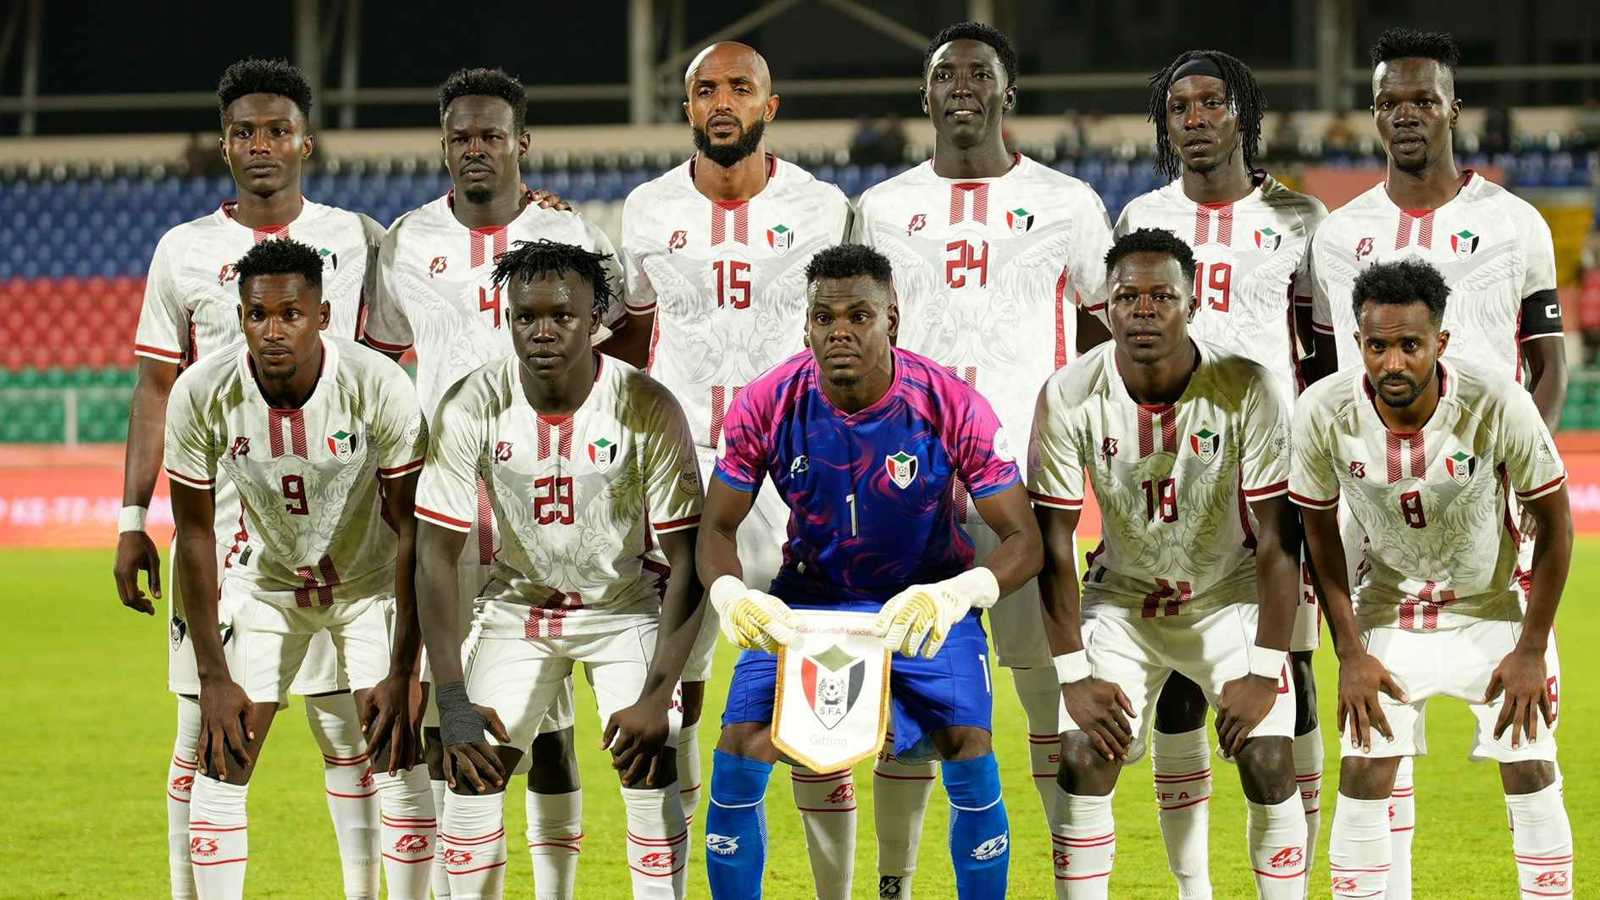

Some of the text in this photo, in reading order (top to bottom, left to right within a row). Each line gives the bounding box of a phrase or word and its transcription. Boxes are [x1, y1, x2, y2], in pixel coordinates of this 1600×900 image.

[712, 260, 751, 309] 15
[946, 239, 989, 289] 24
[479, 283, 501, 330] 4
[1194, 262, 1232, 313] 19
[281, 474, 309, 515] 9
[845, 493, 858, 537] 1
[1141, 478, 1179, 524] 18
[1400, 490, 1427, 529] 8
[978, 654, 992, 697] 1
